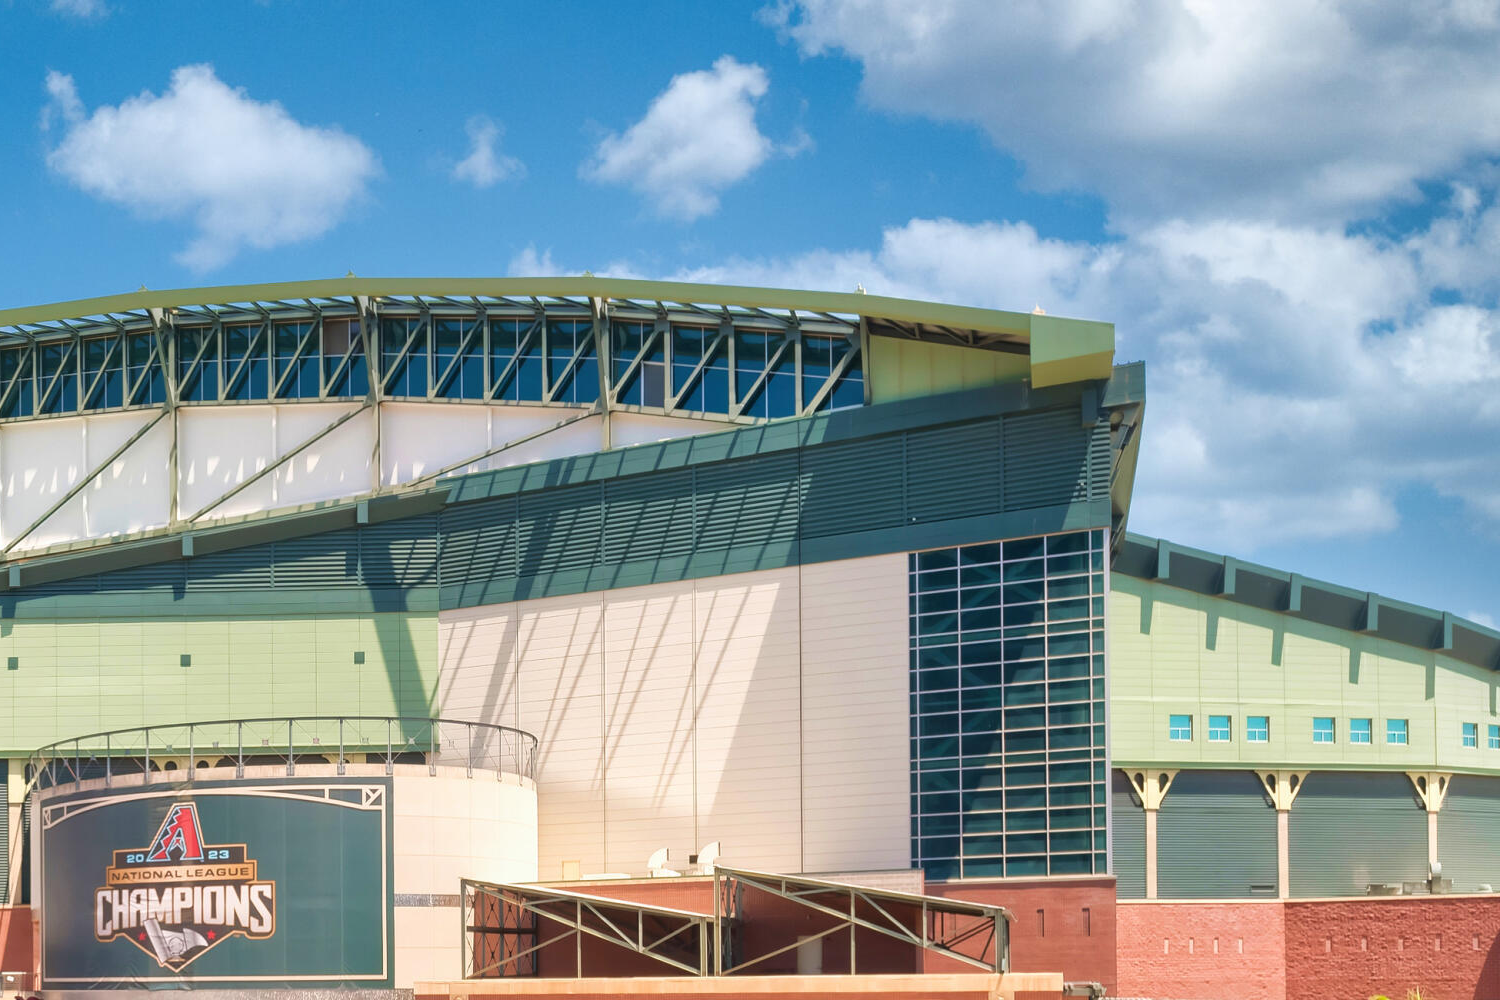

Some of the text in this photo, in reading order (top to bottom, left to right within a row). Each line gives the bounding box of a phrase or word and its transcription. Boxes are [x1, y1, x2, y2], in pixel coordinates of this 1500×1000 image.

[126, 854, 144, 864] 20
[208, 850, 230, 860] 23
[111, 867, 249, 881] NATIONAL LEAGUE
[96, 884, 273, 937] CHAMPIONS
